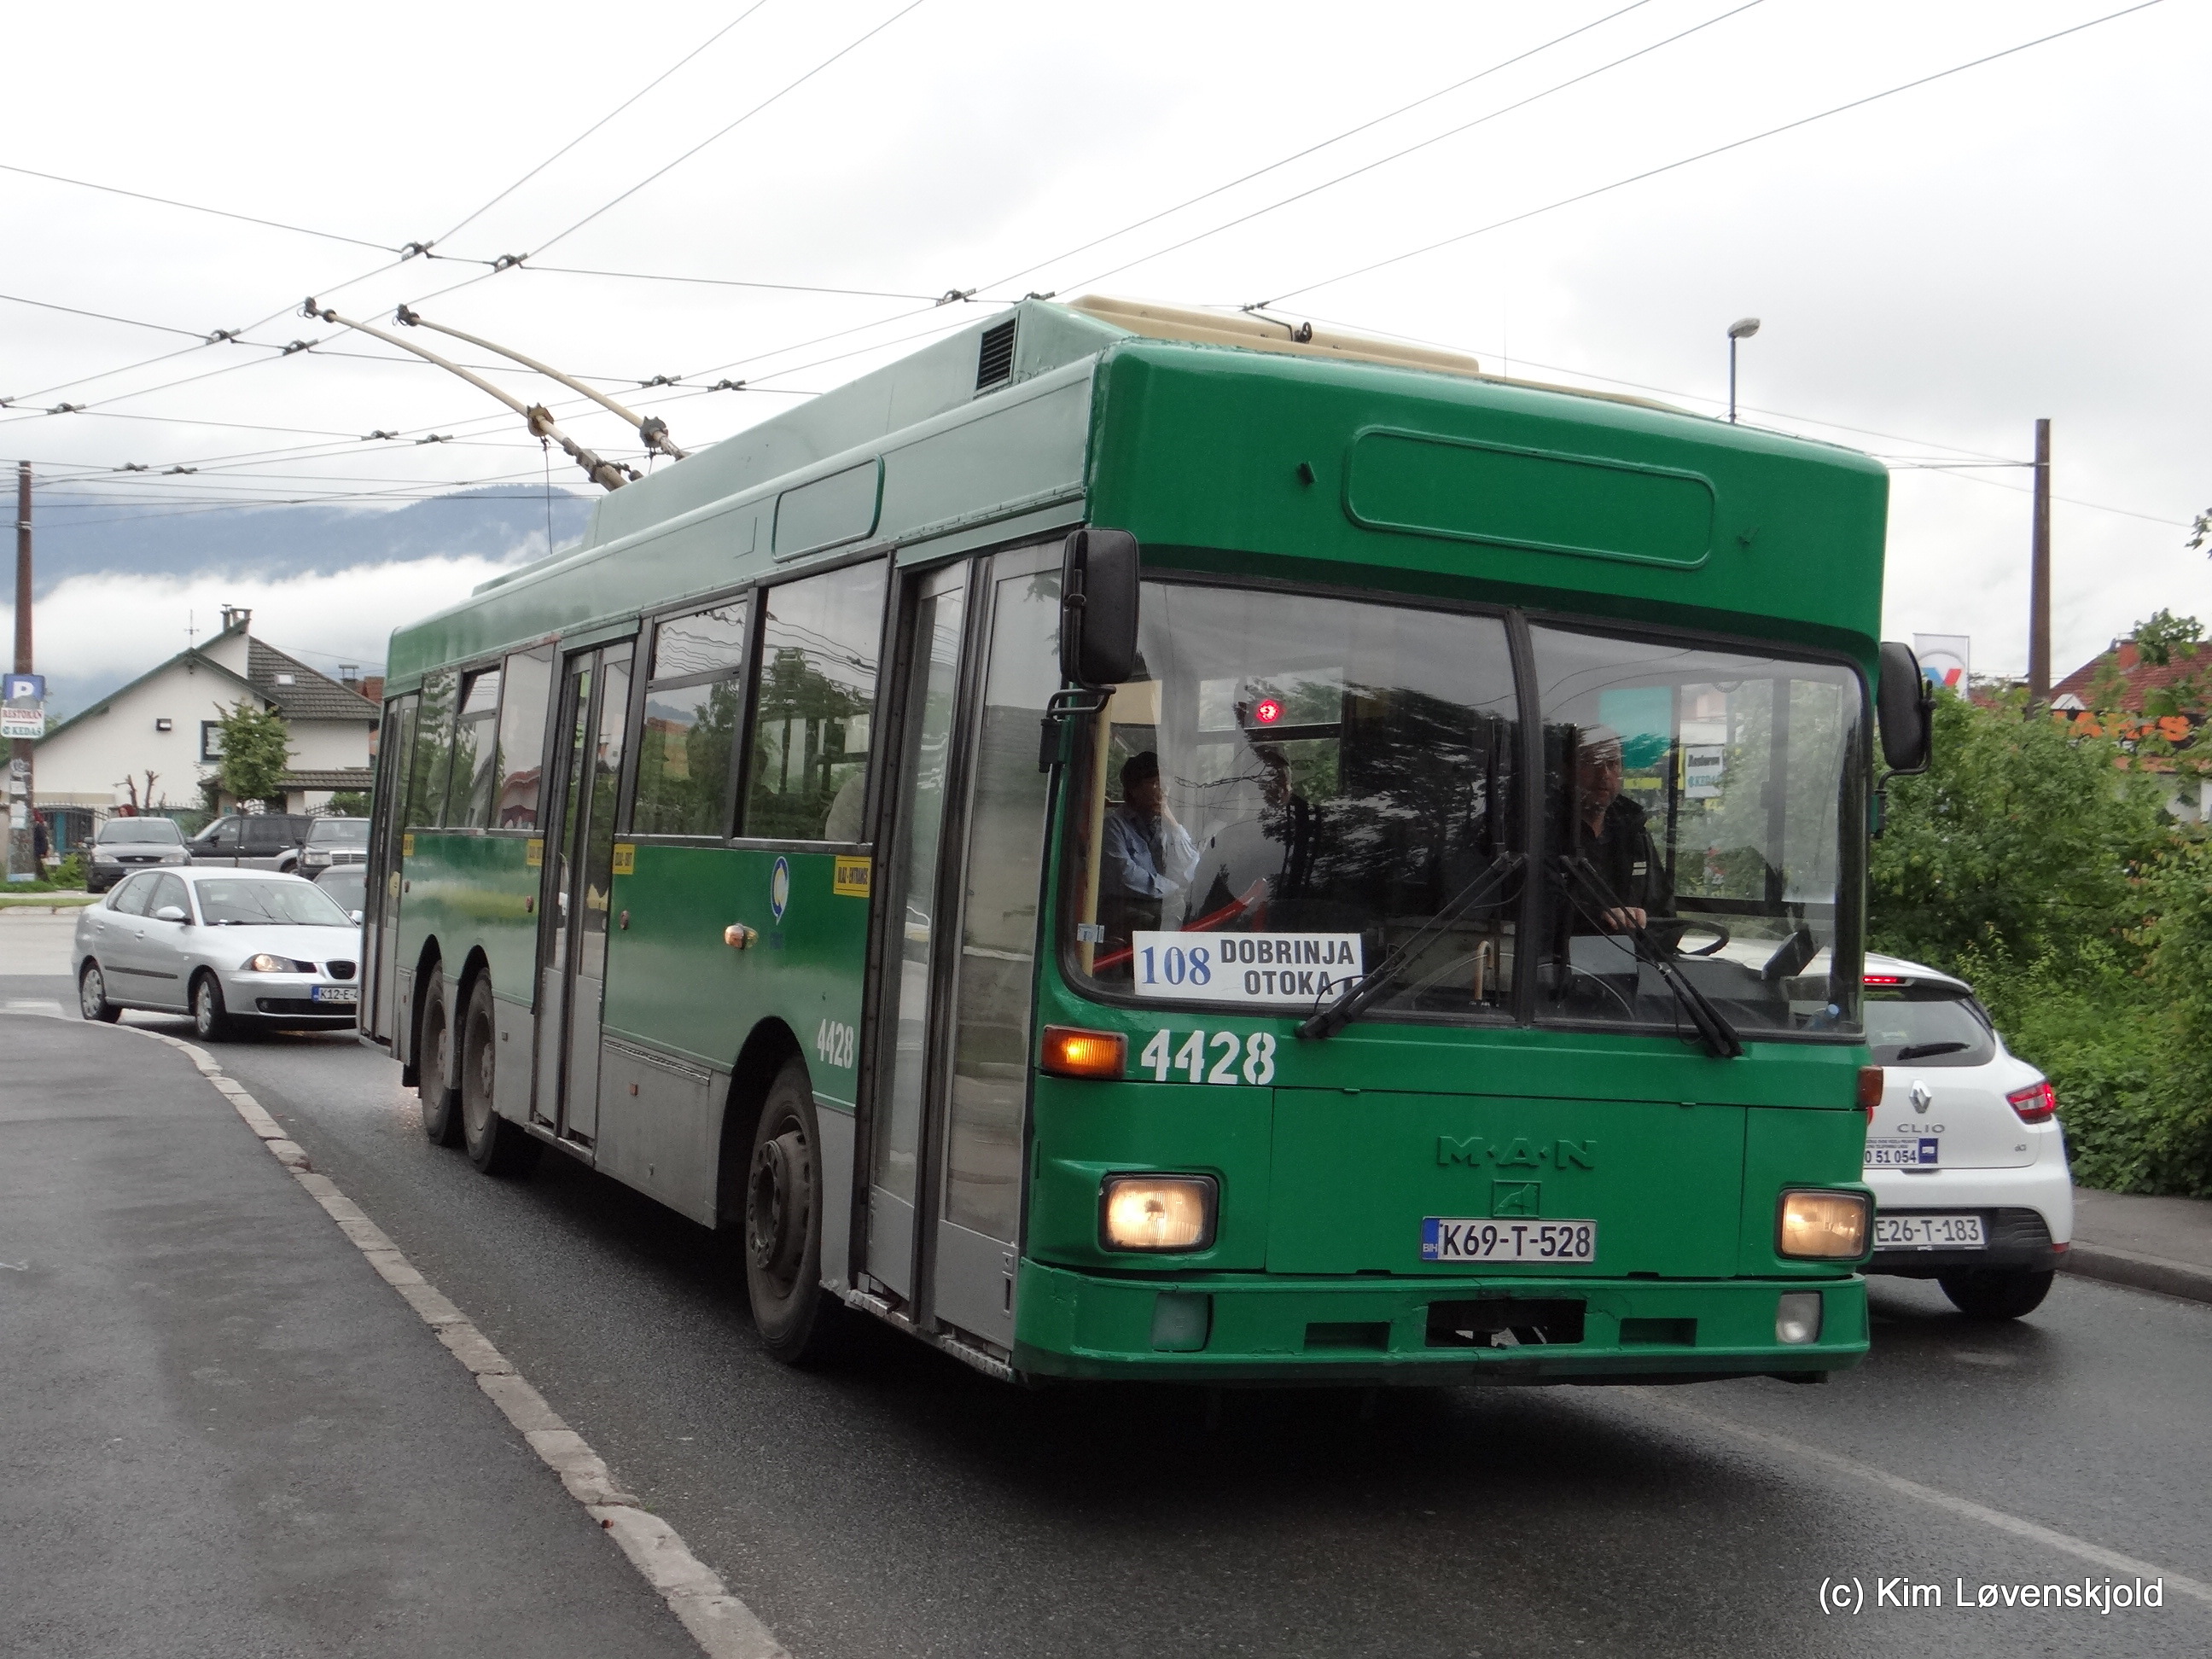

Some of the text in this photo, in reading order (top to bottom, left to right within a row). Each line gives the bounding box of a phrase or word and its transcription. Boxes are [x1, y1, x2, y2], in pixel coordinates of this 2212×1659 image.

[1220, 939, 1354, 965] DOBRINJA
[1140, 946, 1211, 986] 108
[1243, 969, 1334, 996] OTOKA
[817, 1018, 853, 1069] 4428
[1140, 1029, 1276, 1086] 4428
[1897, 1123, 1945, 1133] CLIO
[1876, 1150, 1891, 1163] 51
[1894, 1150, 1917, 1163] 054
[1442, 1225, 1591, 1257] K69-T-528
[1875, 1219, 1979, 1242] E26-T-183
[1423, 1243, 1438, 1253] BIH
